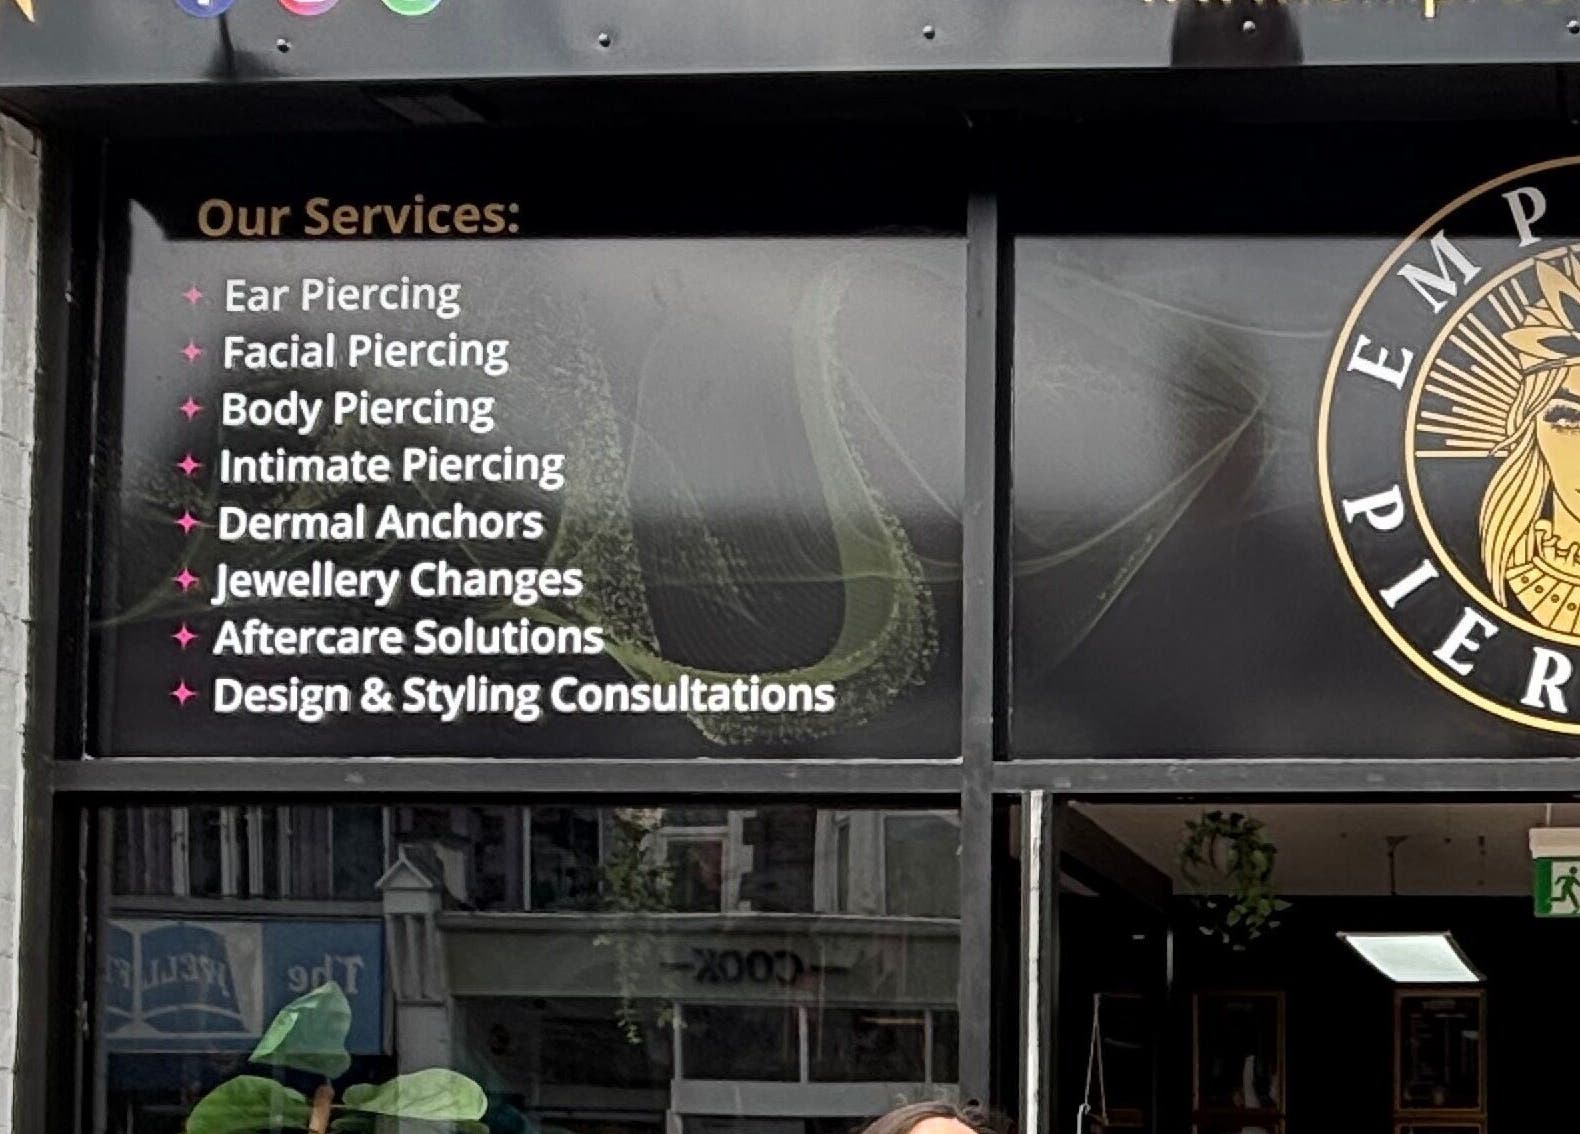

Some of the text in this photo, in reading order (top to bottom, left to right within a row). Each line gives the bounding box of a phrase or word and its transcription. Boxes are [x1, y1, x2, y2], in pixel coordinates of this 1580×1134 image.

[198, 195, 519, 238] Our Services:
[226, 276, 462, 320] Ear Piercing
[224, 331, 510, 377] Facial Piercing
[222, 388, 496, 436] Body Piercing
[220, 445, 568, 492] Intimate Piercing
[218, 502, 544, 541] Dermal Anchors
[210, 560, 584, 607] Jewellery Changes
[212, 616, 608, 656] Aftercare Solutions
[214, 674, 836, 723] Design & Styling Consultations
